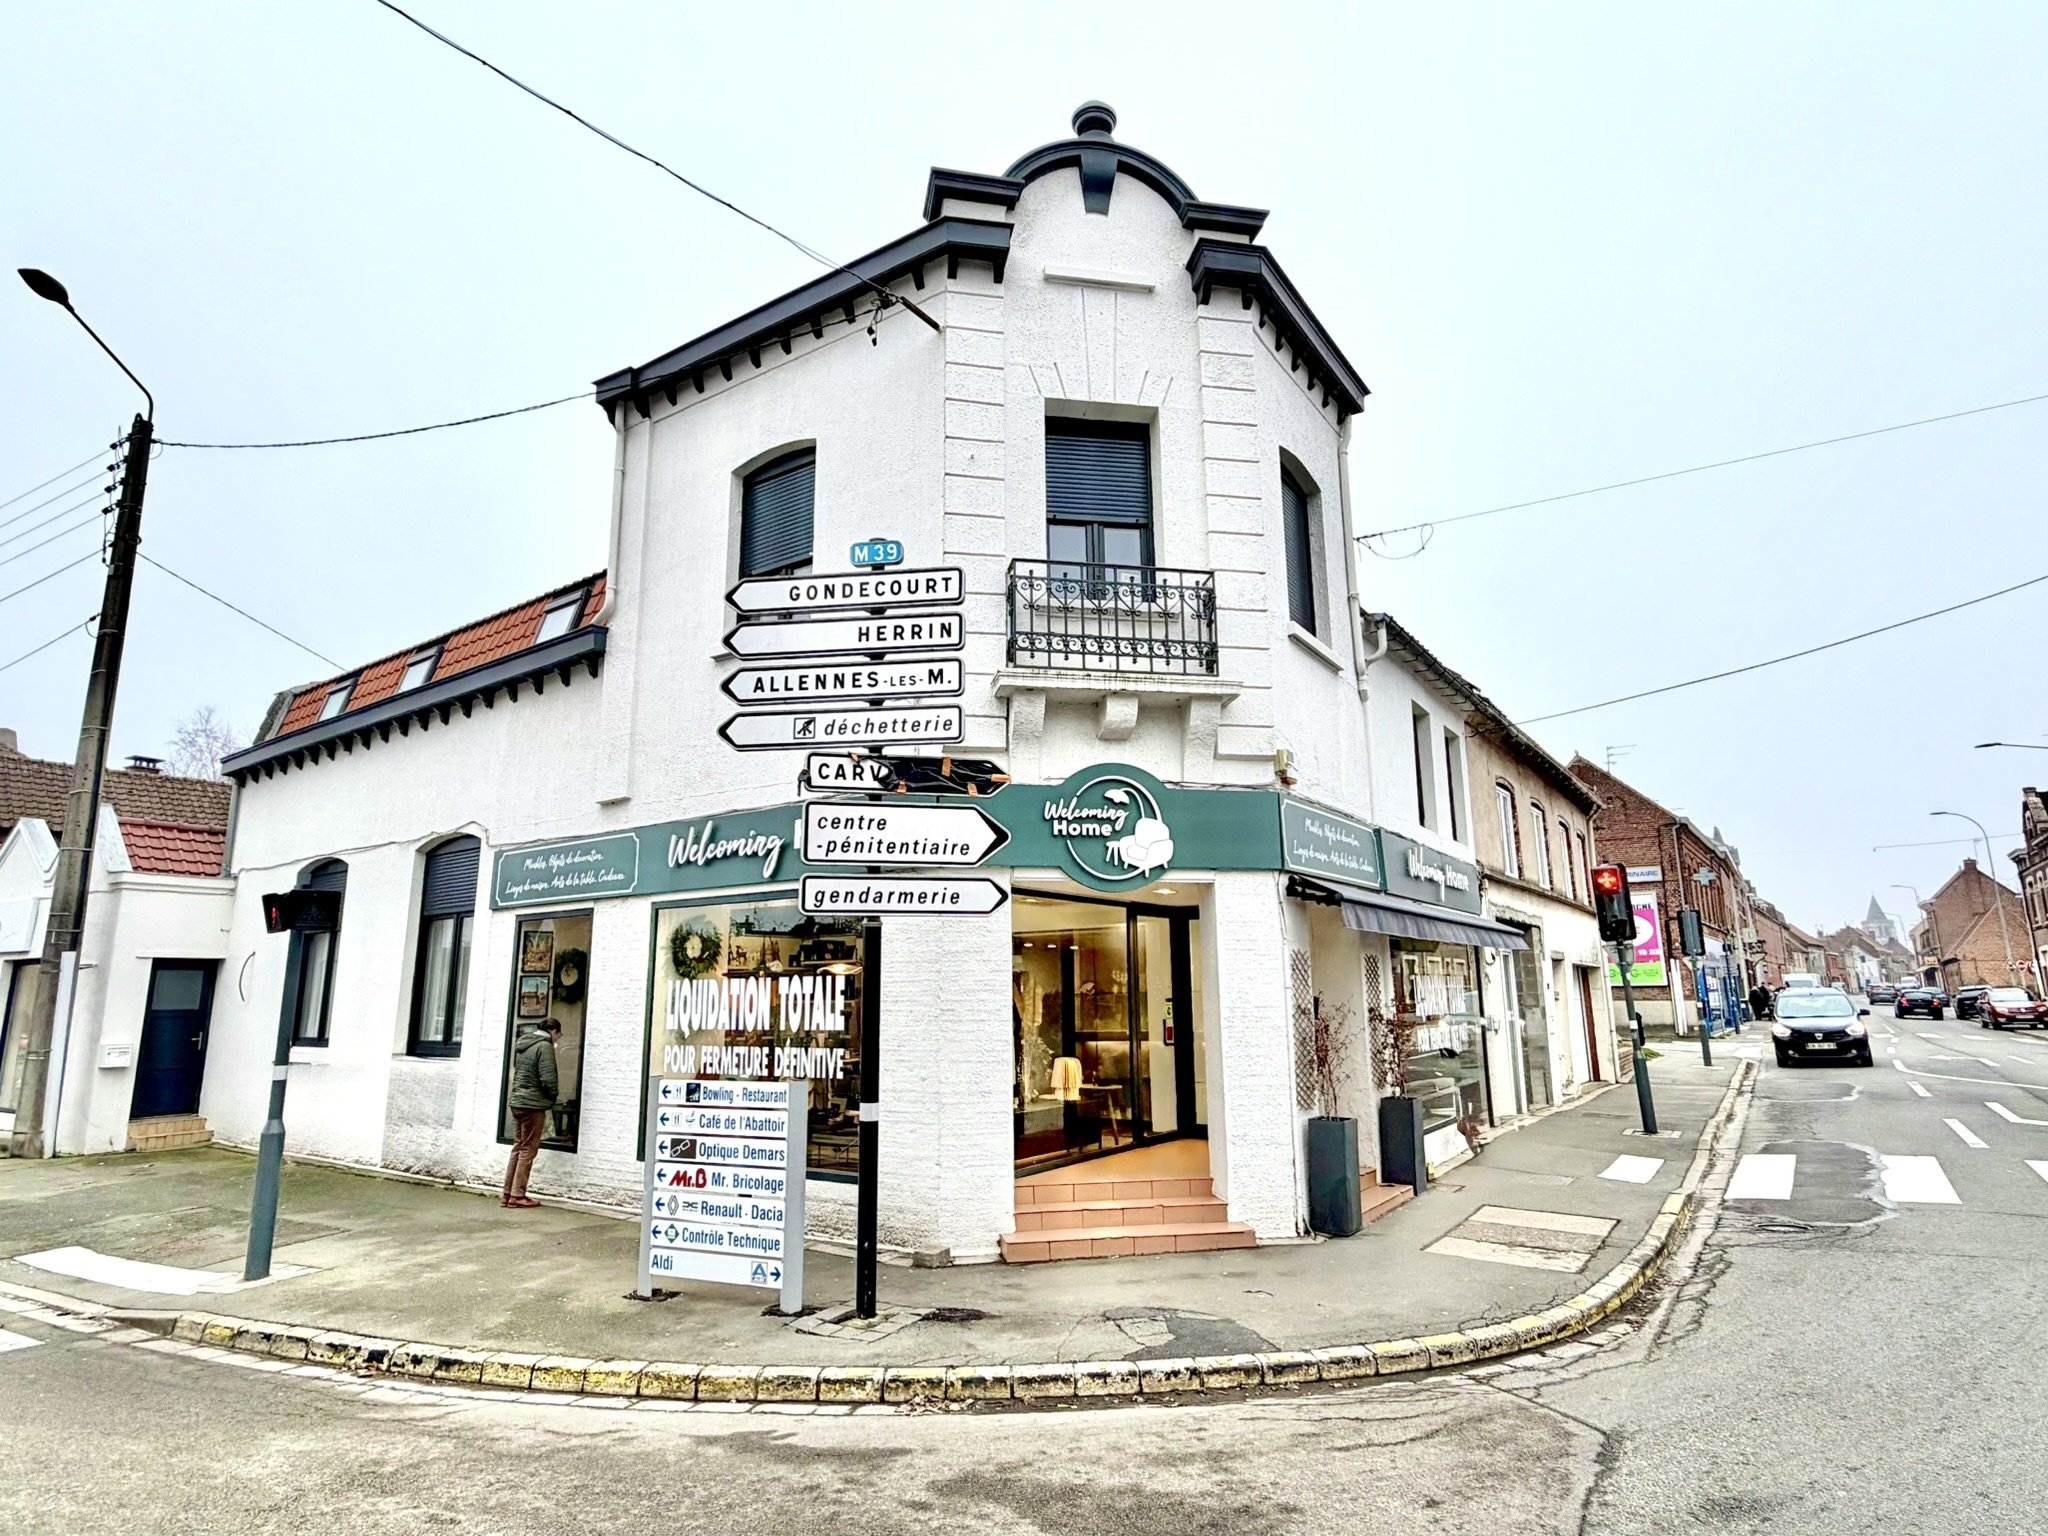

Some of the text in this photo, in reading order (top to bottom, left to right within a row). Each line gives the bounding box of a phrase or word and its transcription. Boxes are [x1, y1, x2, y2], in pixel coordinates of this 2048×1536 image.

[854, 544, 898, 562] M 39
[789, 577, 953, 602] GONDECOURT
[858, 622, 953, 642] HERRIN
[753, 669, 953, 693] ALLENNES-LES-M.
[824, 716, 953, 737] déchetterie
[818, 763, 883, 782] CARV
[817, 815, 887, 830] centre
[1044, 796, 1130, 831] Welcoming
[1053, 820, 1113, 836] Home
[668, 820, 785, 879] Welcoming
[1446, 864, 1469, 891] Home
[814, 886, 960, 908] gendarmerie
[666, 974, 846, 1039] LIQUIDATION TOTALE
[664, 1037, 846, 1080] POUR FERMETURE DÉFINITIVE
[703, 1086, 734, 1104] Bowling
[742, 1087, 787, 1103] Restaurant
[699, 1113, 785, 1132] Café de l'Abattoir
[699, 1142, 785, 1161] Optique Demars
[711, 1172, 729, 1187] Mr.
[733, 1173, 784, 1194] Bricolage
[701, 1200, 742, 1218] Renault
[751, 1204, 783, 1221] Dacia
[682, 1226, 780, 1253] Contrôle Technique
[652, 1254, 673, 1271] Aldi
